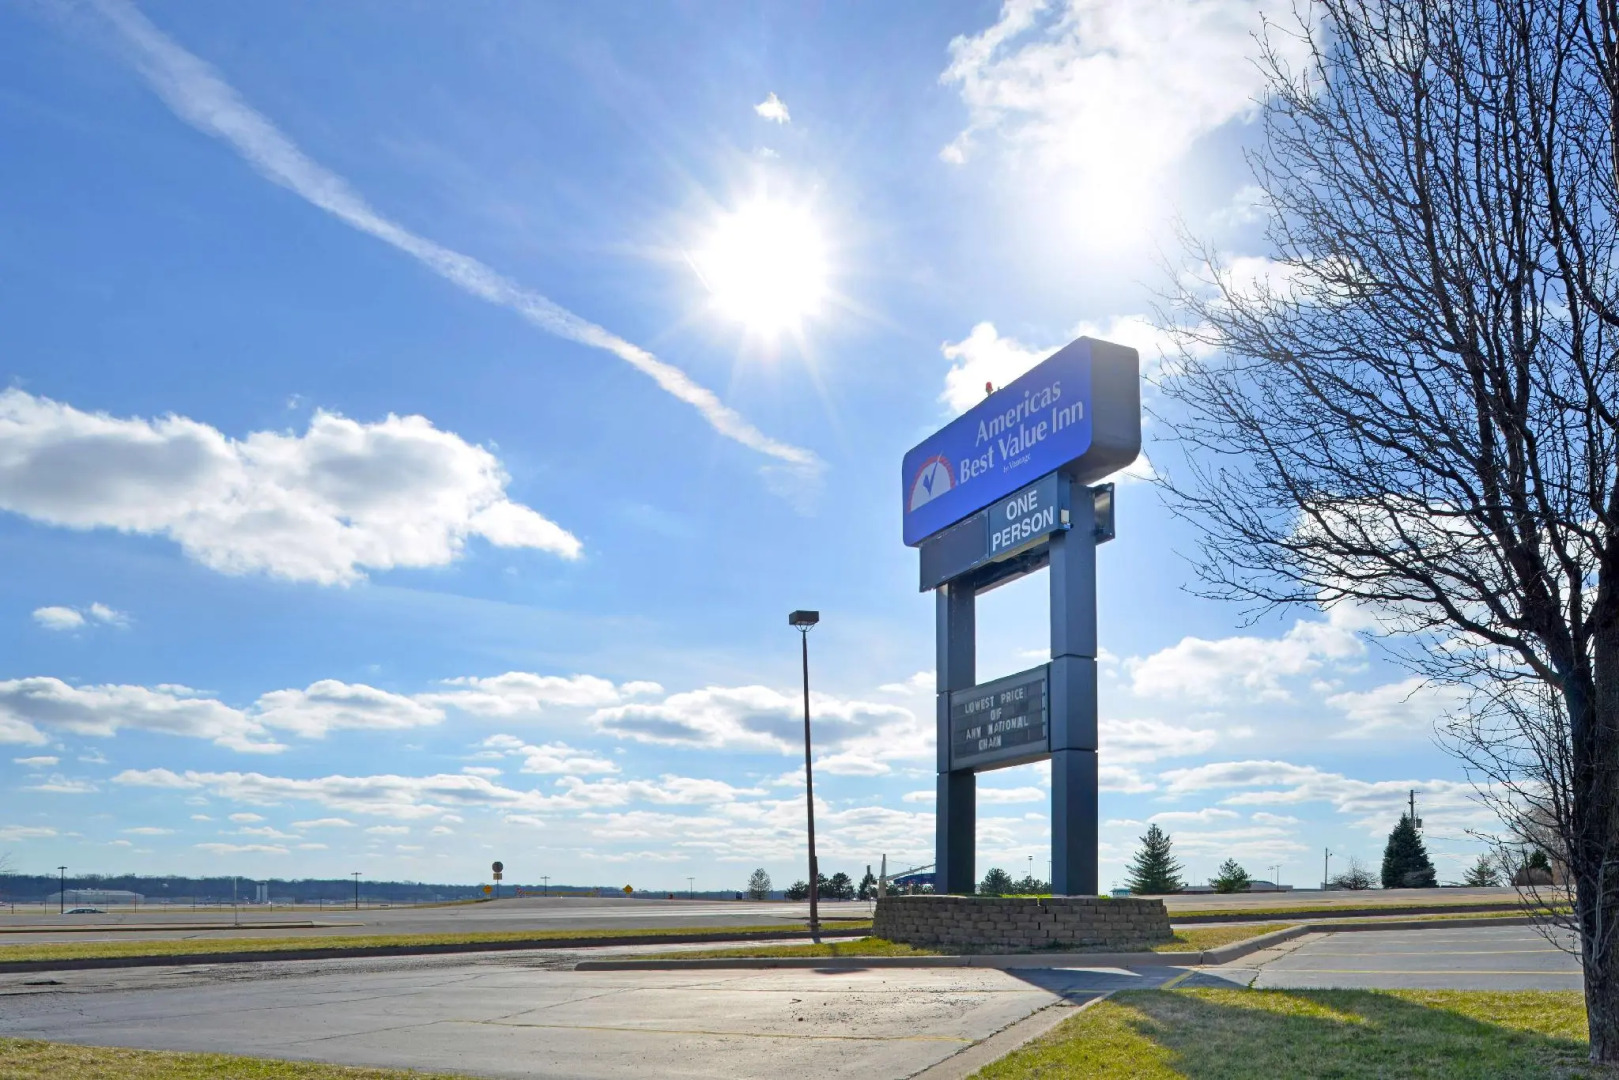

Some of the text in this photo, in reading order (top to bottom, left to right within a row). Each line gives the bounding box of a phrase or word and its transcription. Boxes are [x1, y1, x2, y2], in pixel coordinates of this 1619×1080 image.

[975, 381, 1061, 447] Americas
[960, 400, 1083, 485] Best Value Inn
[1006, 490, 1038, 520] ONE
[992, 506, 1054, 551] PERSON
[965, 688, 1023, 714] LOWEST PRICE
[991, 709, 1002, 720] OF
[966, 716, 1029, 740] ANY NATIONAL
[979, 735, 1001, 750] CHAIN
